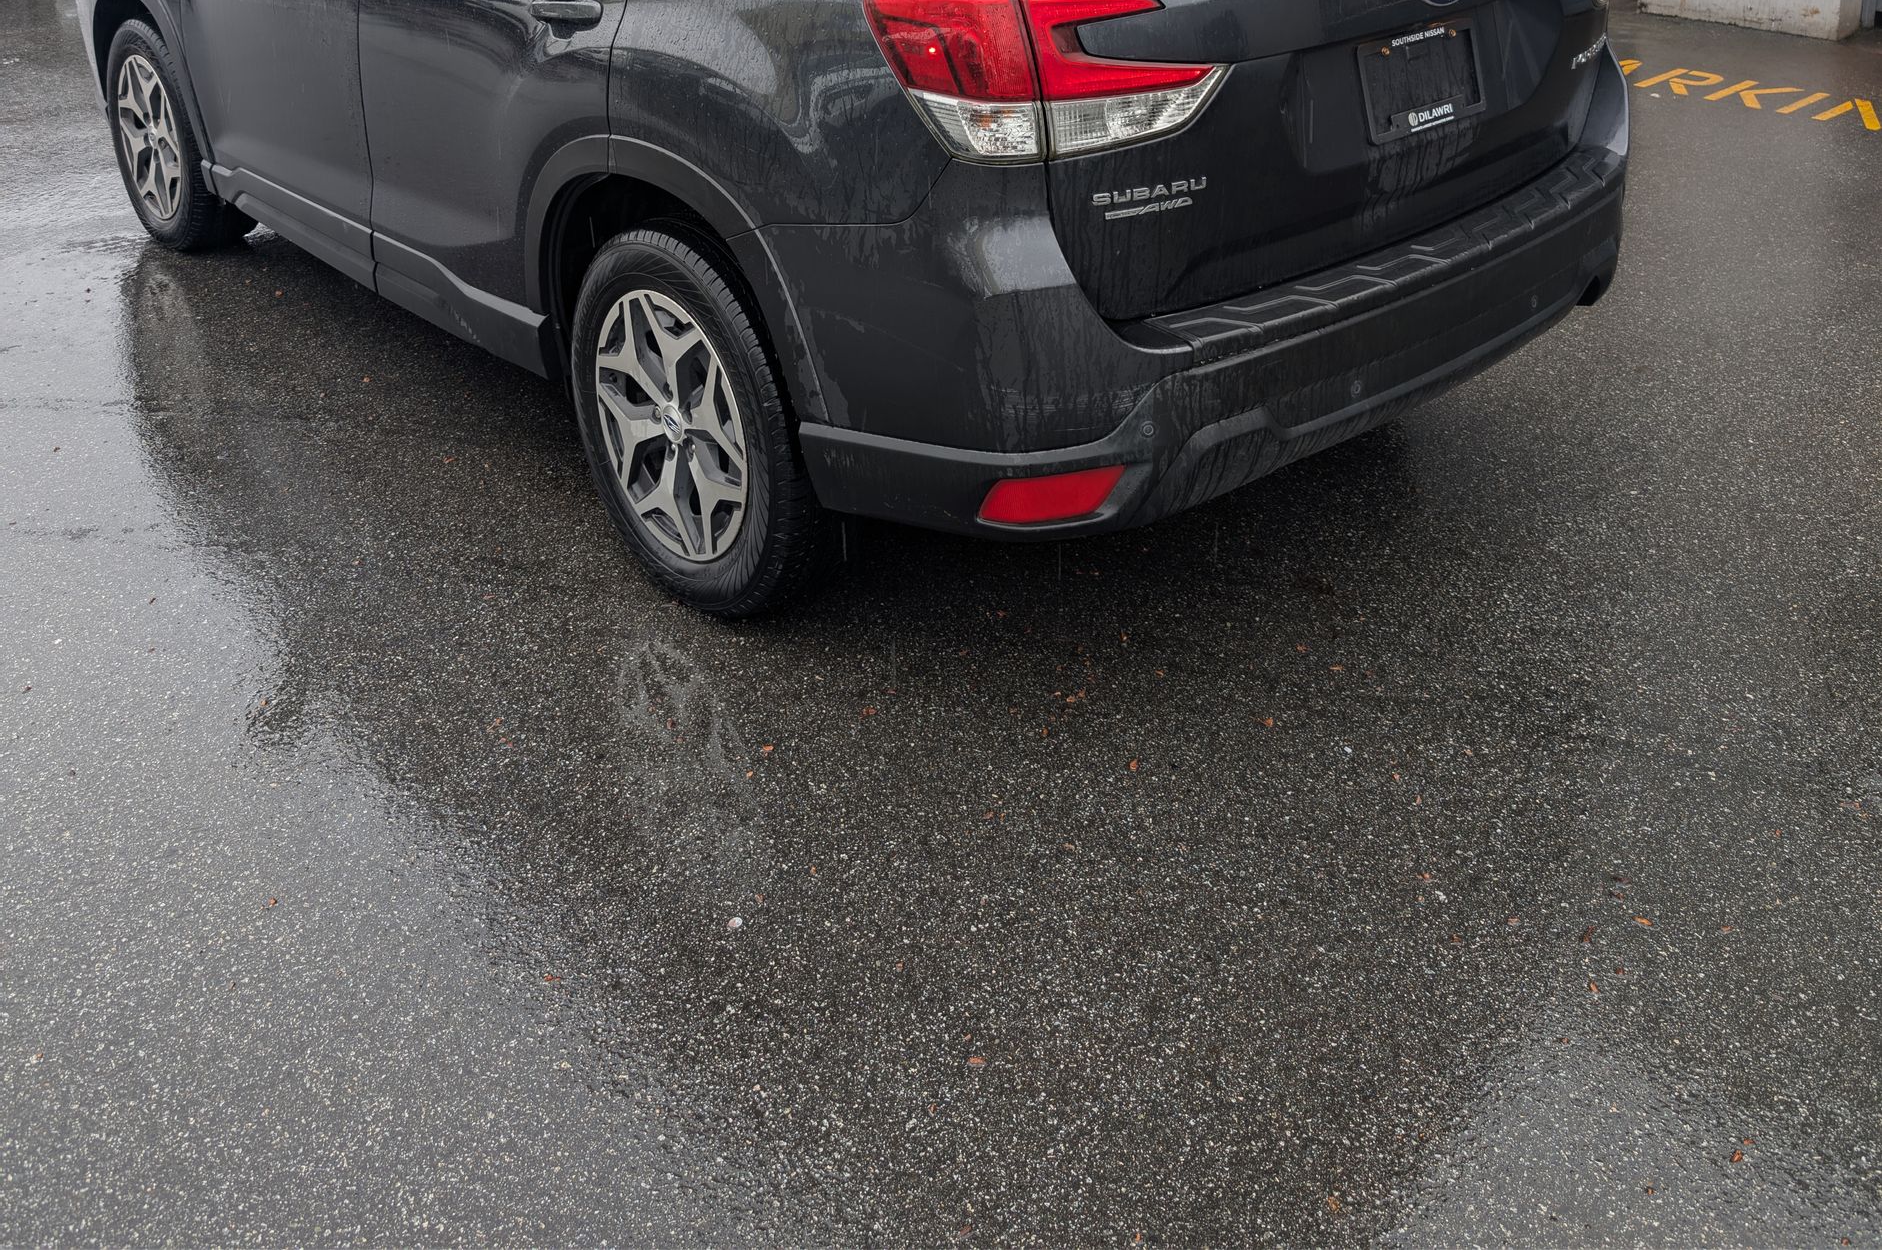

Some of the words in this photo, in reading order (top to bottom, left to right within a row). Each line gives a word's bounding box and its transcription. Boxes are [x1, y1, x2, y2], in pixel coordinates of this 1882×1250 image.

[1391, 32, 1424, 47] SOUTHSIDE
[1424, 26, 1445, 39] NISSAN
[1418, 103, 1453, 123] DILAWRI
[1091, 176, 1207, 206] SUBARU
[1138, 197, 1193, 215] AWD
